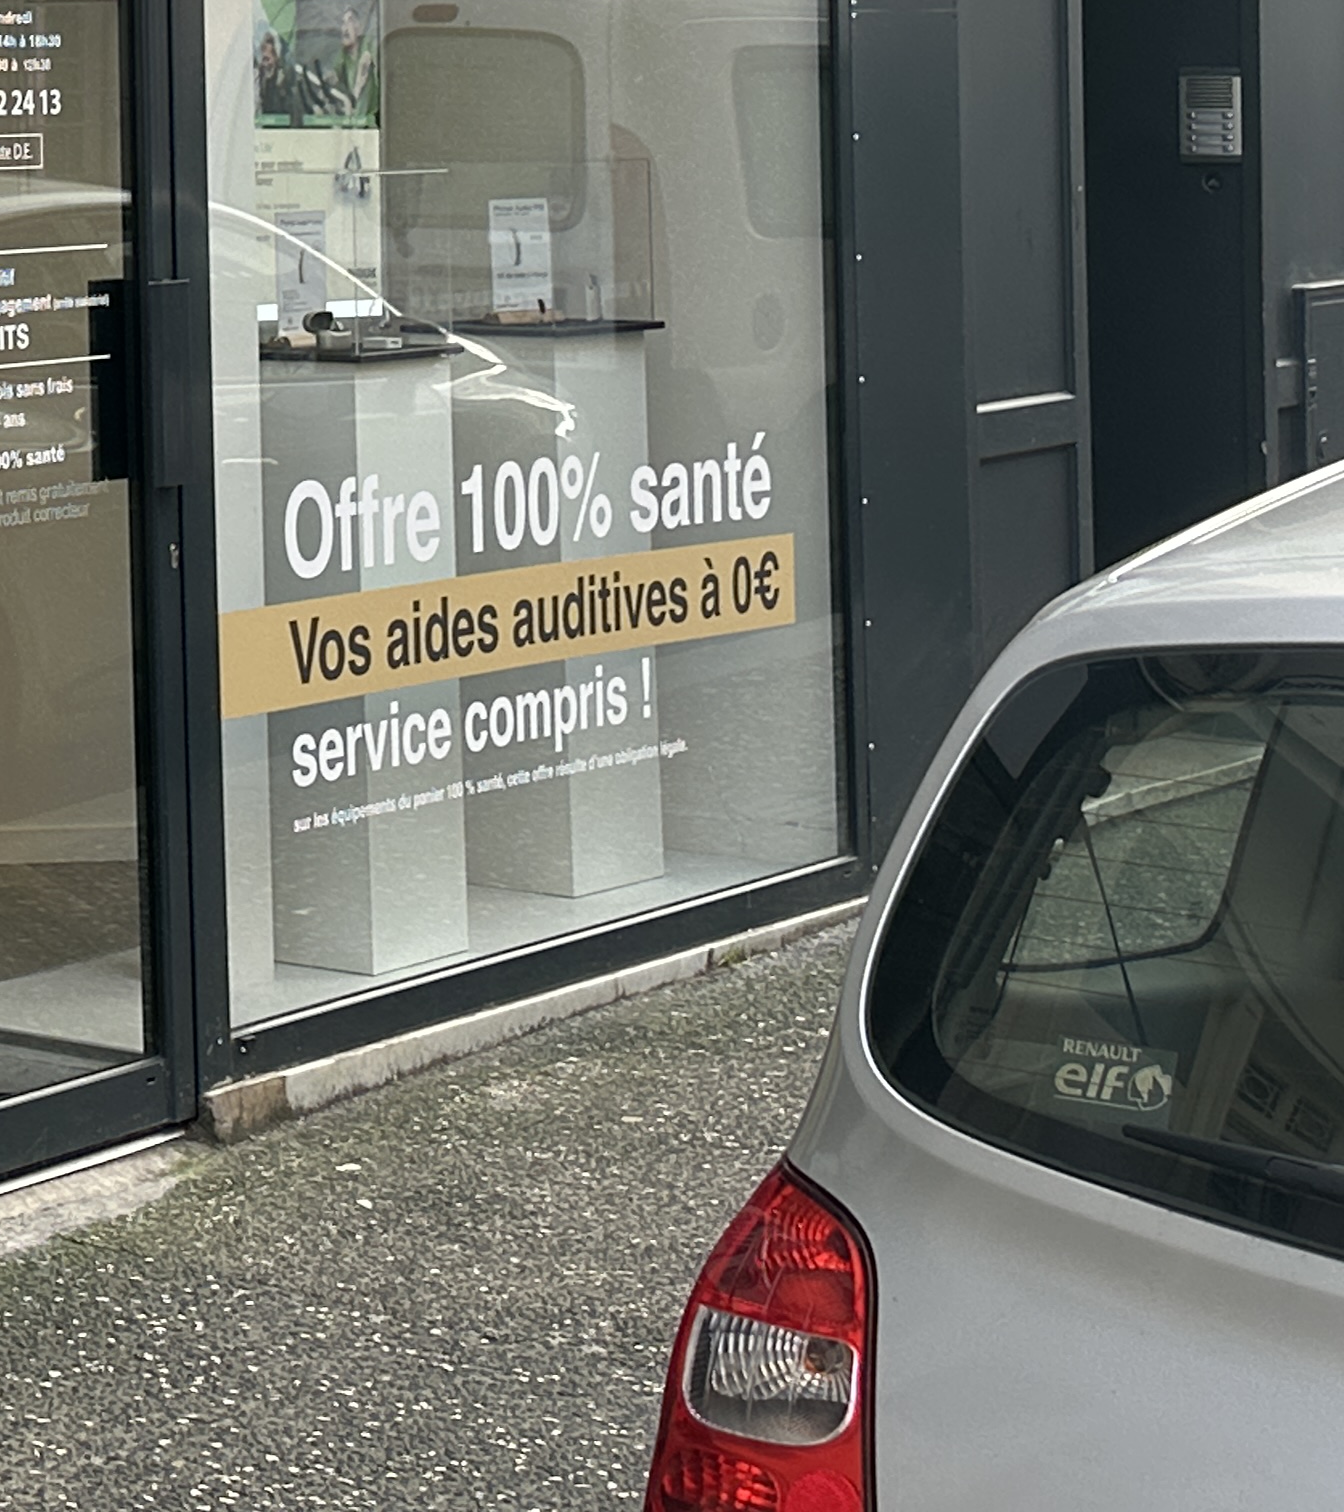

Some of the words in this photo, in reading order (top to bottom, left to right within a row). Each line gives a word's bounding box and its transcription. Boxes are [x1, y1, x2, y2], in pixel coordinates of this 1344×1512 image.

[19, 34, 26, 47] à
[11, 58, 18, 71] à
[11, 89, 36, 115] 24
[39, 89, 62, 115] 13
[16, 382, 45, 398] sans
[47, 377, 73, 394] frais
[3, 411, 26, 428] ans
[25, 444, 66, 466] santé
[5, 486, 37, 505] remis
[283, 473, 441, 579] Offre
[461, 451, 612, 555] 100%
[629, 432, 772, 533] santé
[289, 615, 372, 684] Vos
[386, 597, 499, 669] aides
[512, 570, 689, 647] auditives
[700, 558, 721, 618] à
[733, 550, 780, 614] 0€
[292, 702, 452, 788] service
[464, 664, 628, 752] compris
[641, 657, 651, 719] !
[293, 816, 312, 833] sur
[313, 812, 329, 828] les
[330, 798, 396, 826] équipements
[398, 793, 412, 810] du
[447, 781, 463, 799] 100
[1063, 1037, 1142, 1062] RENAULT
[1054, 1060, 1130, 1101] elf
